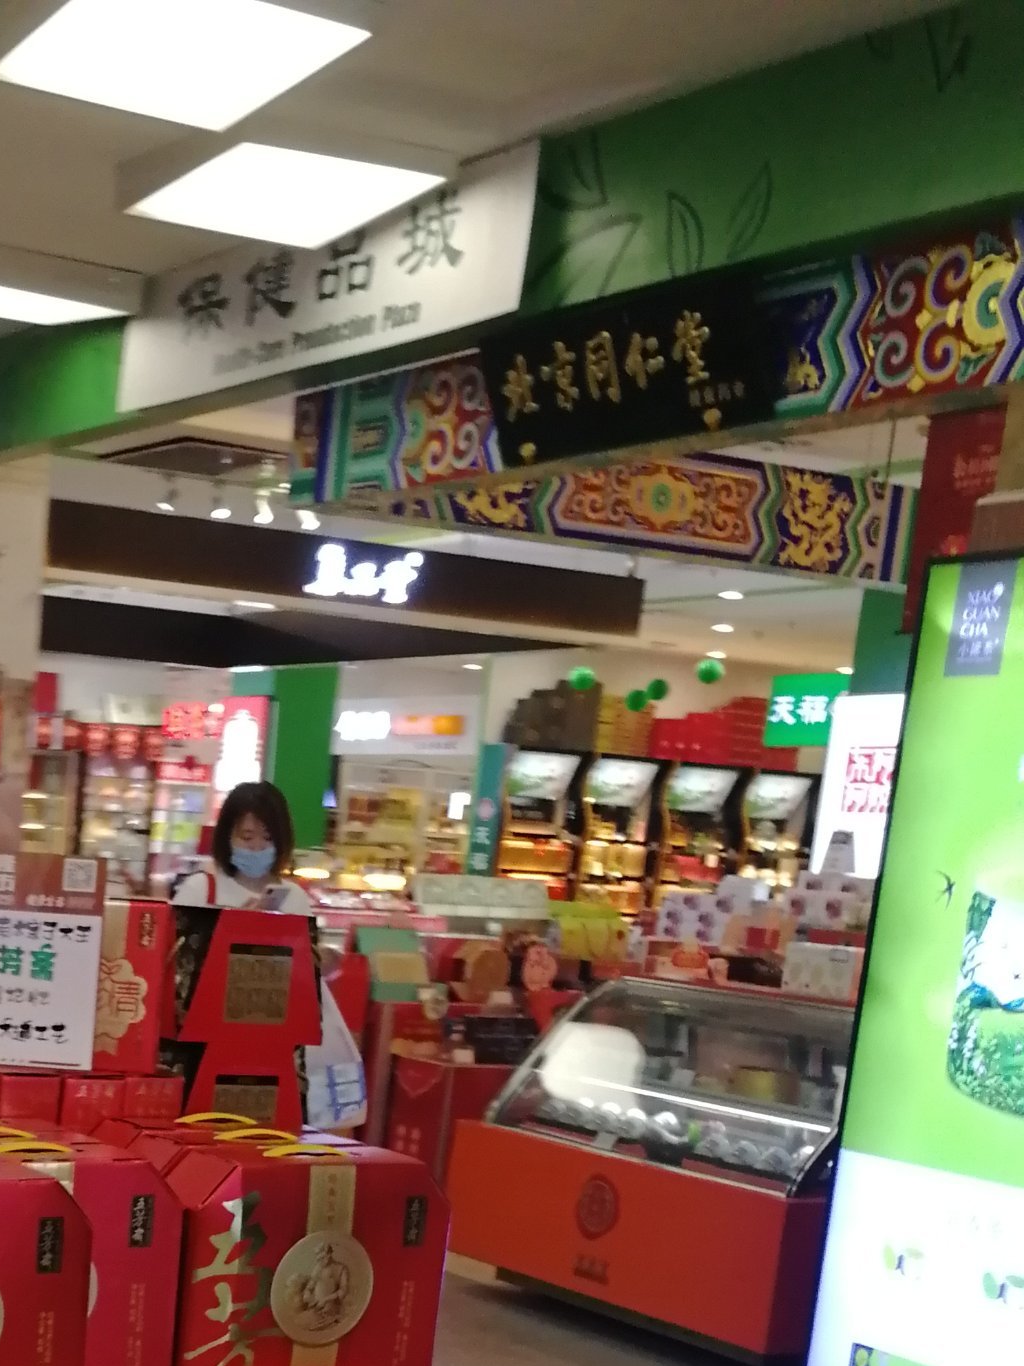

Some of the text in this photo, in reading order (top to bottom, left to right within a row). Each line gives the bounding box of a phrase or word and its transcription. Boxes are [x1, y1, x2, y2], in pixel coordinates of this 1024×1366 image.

[502, 309, 711, 424] 北京同仁堂
[767, 695, 846, 725] 天福
